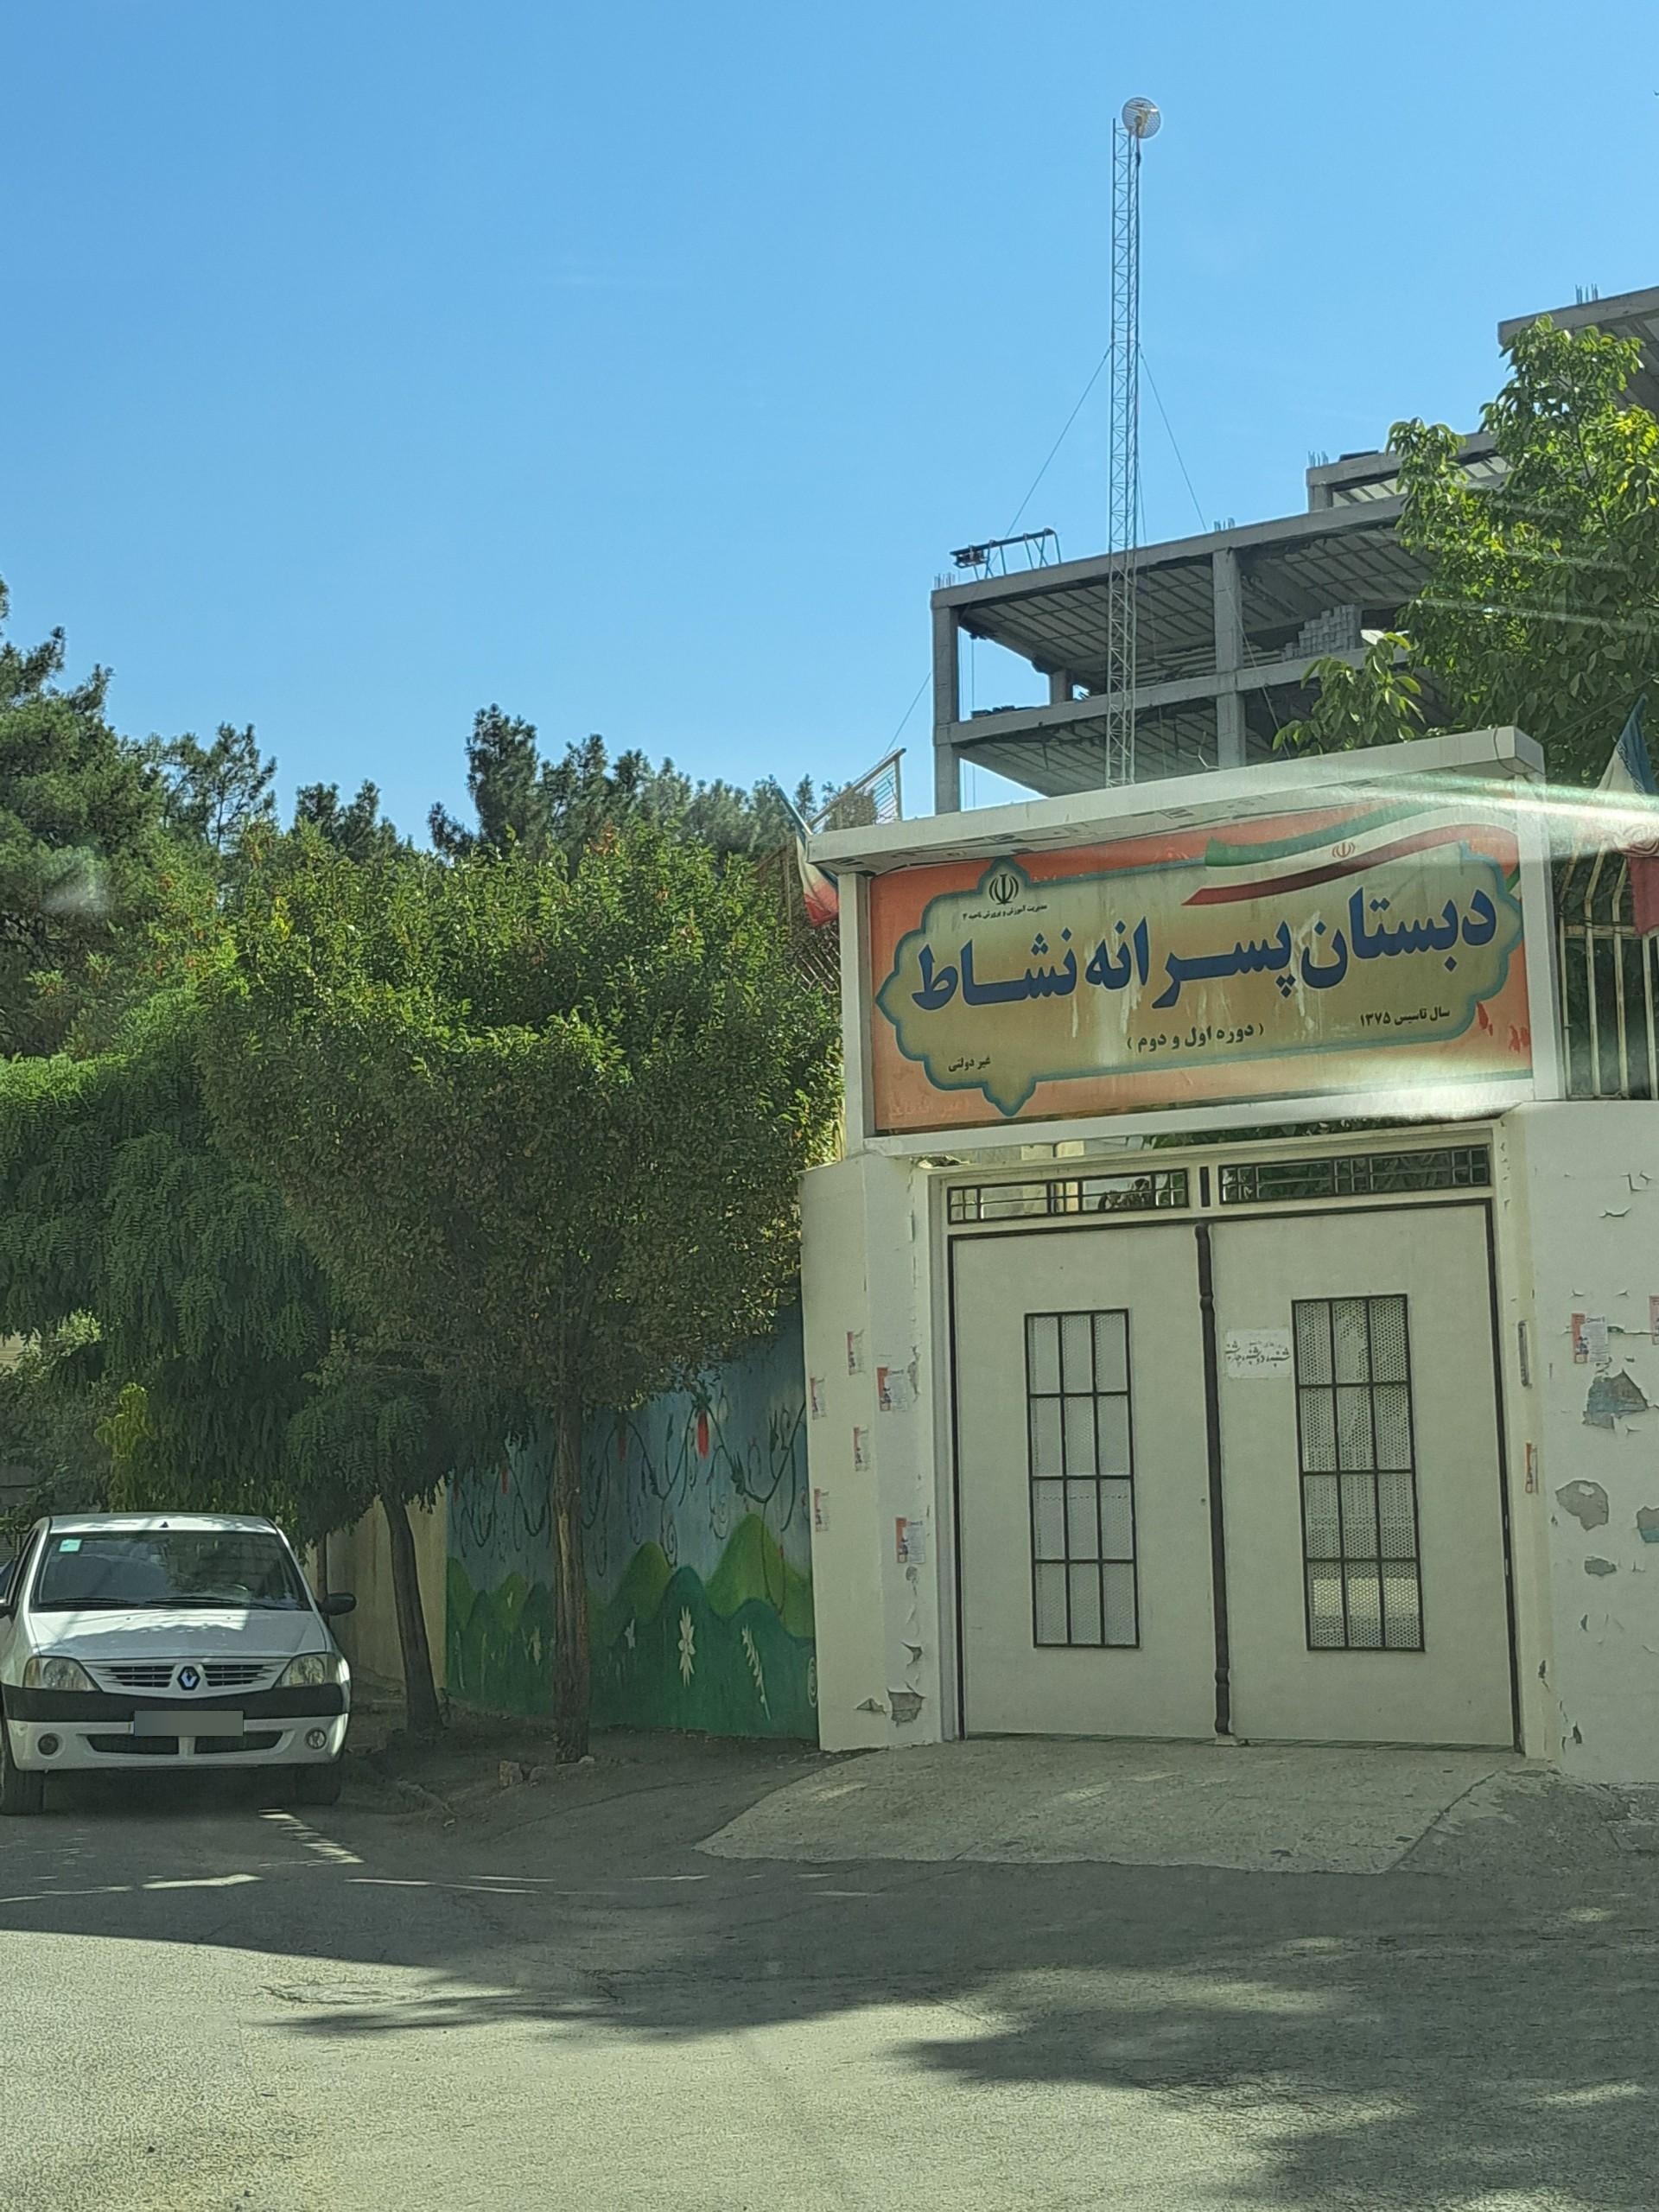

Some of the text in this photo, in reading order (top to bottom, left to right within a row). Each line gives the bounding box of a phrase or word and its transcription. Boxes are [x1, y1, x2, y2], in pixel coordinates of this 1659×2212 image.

[912, 887, 1497, 1011] دبستان پسرانه نشاط
[1359, 1011, 1392, 1028] ۱۳۷۵
[1430, 1006, 1451, 1021] سال
[1171, 1034, 1180, 1050] و
[1184, 1025, 1212, 1048] اول
[948, 1055, 992, 1072] غیر دولتی
